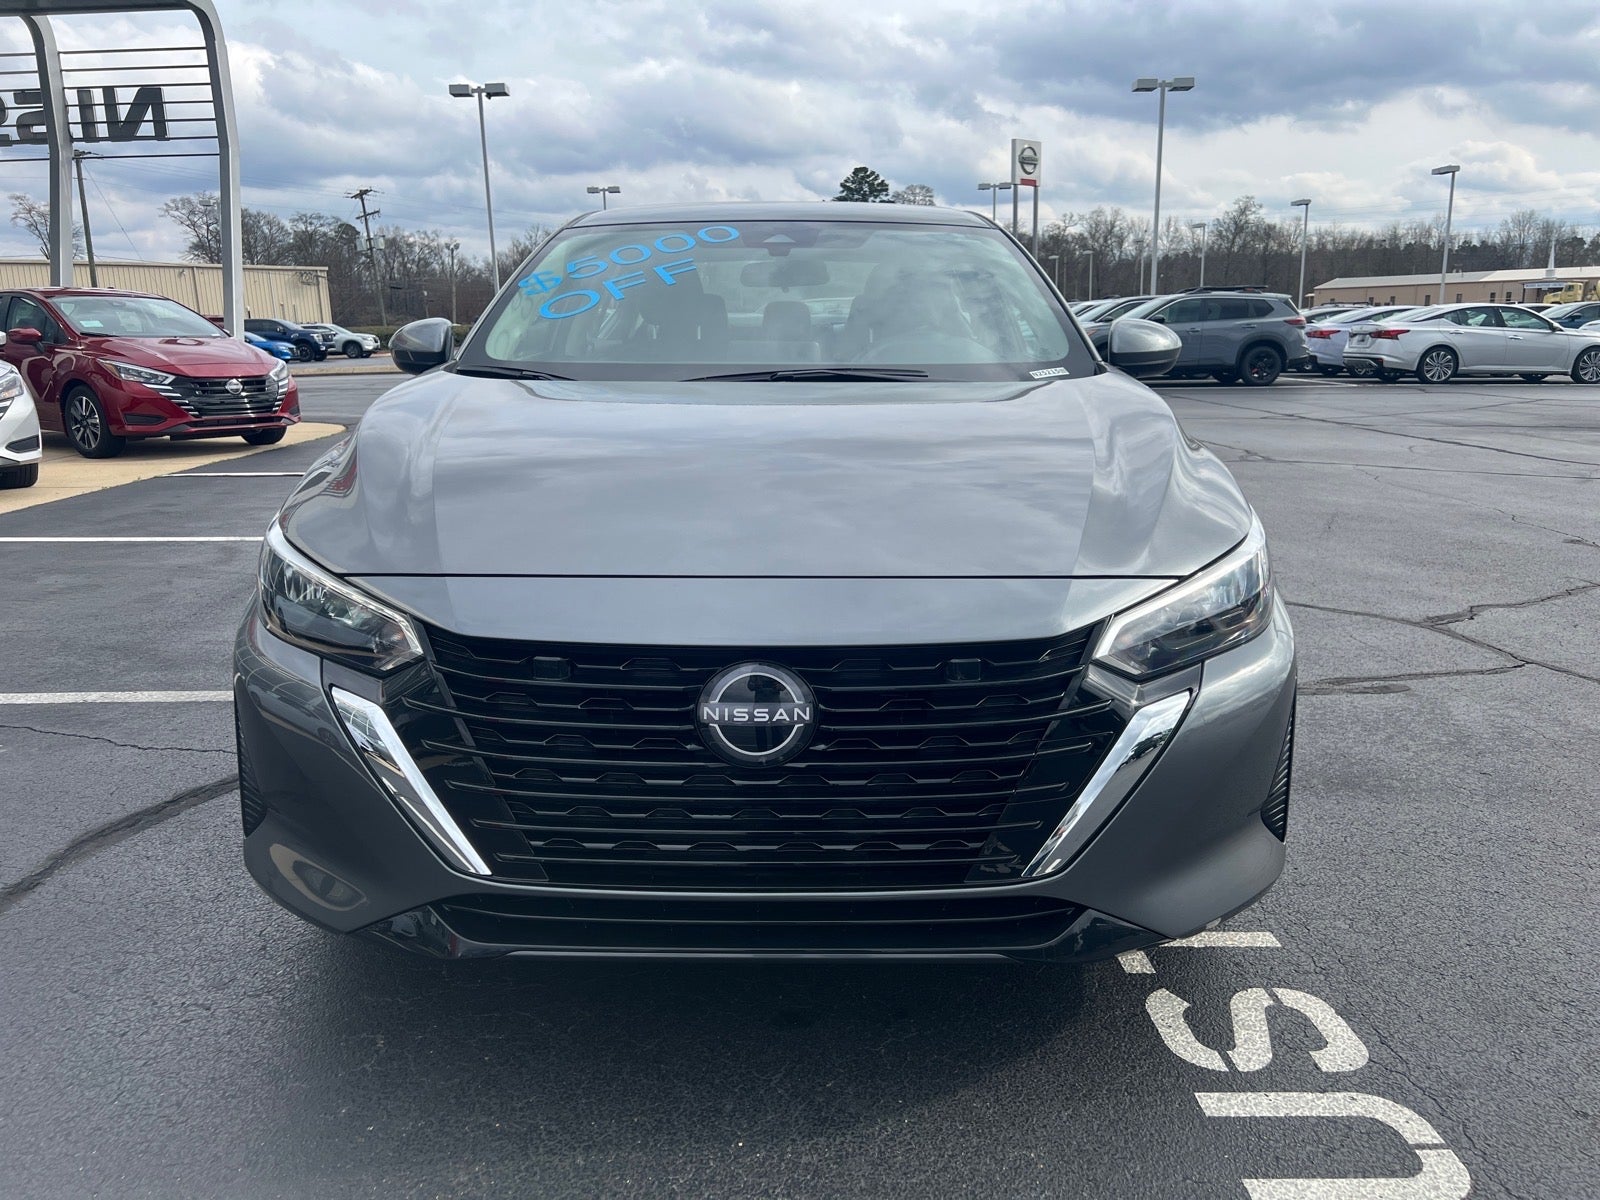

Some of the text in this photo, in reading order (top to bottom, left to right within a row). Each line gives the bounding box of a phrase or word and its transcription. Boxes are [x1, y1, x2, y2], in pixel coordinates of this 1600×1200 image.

[518, 225, 740, 296] $5000
[539, 257, 697, 320] OFF
[703, 706, 810, 722] NISSAN
